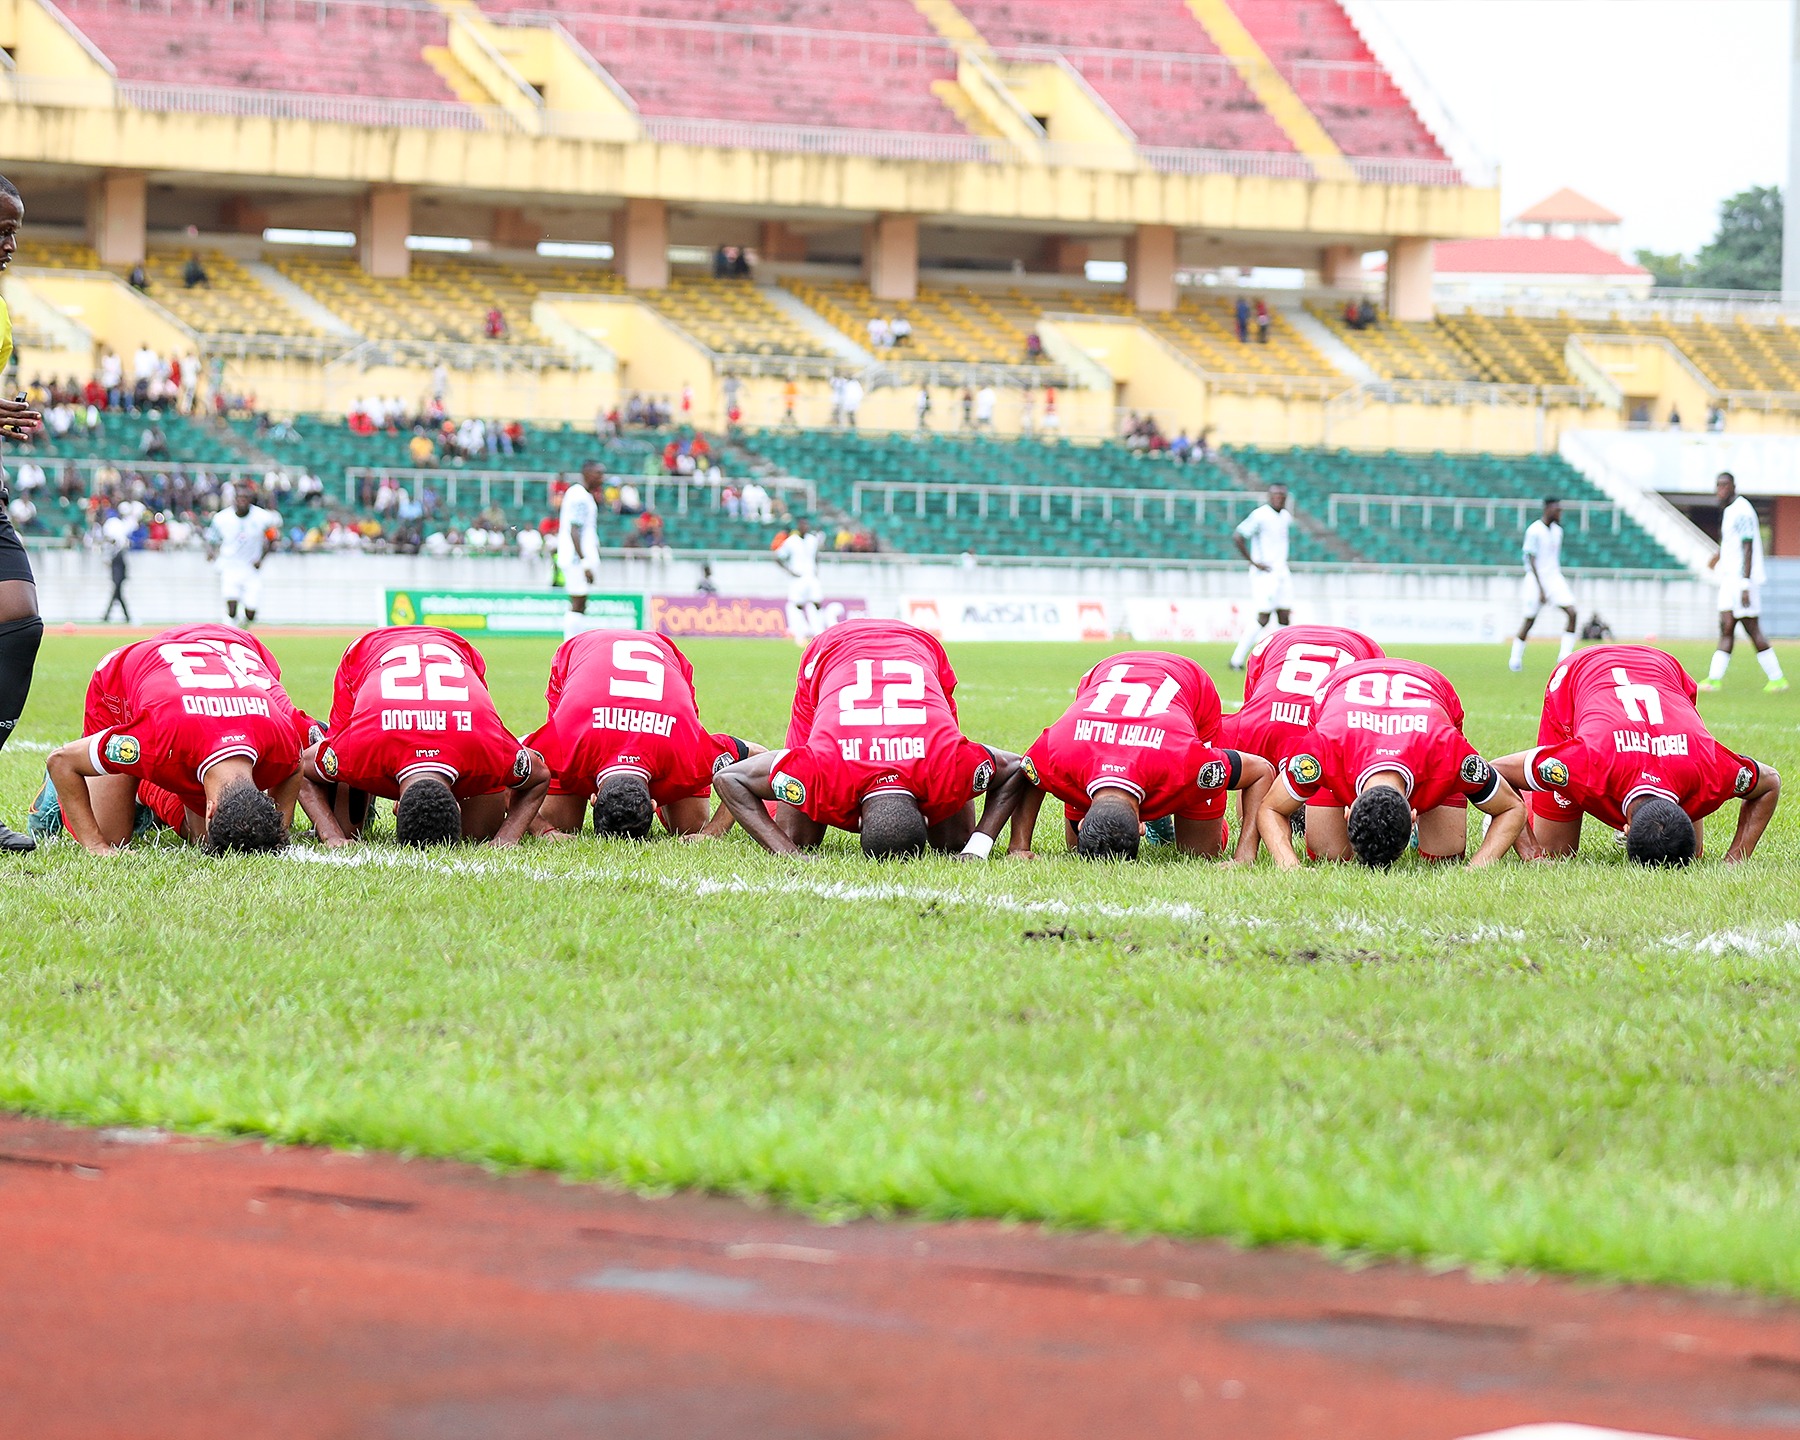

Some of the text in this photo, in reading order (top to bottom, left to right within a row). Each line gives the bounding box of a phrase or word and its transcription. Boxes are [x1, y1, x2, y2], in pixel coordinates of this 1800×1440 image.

[651, 597, 786, 635] Fondation
[157, 639, 271, 690] 33
[380, 640, 470, 702] 22
[609, 639, 665, 702] 5
[182, 694, 270, 717] HAIMOUD
[837, 659, 928, 726] 27
[1082, 664, 1182, 718] 14
[1343, 672, 1432, 709] 30
[1611, 667, 1665, 725] 4
[381, 709, 472, 731] EL AMLOUD
[592, 706, 677, 738] JABRANE
[1269, 701, 1312, 727] TIMI
[1346, 710, 1429, 736] BOUHRA
[837, 736, 926, 762] BOULY JR.
[1073, 719, 1166, 750] ATTIAT ALLAH
[1612, 729, 1690, 758] ABOUFATH
